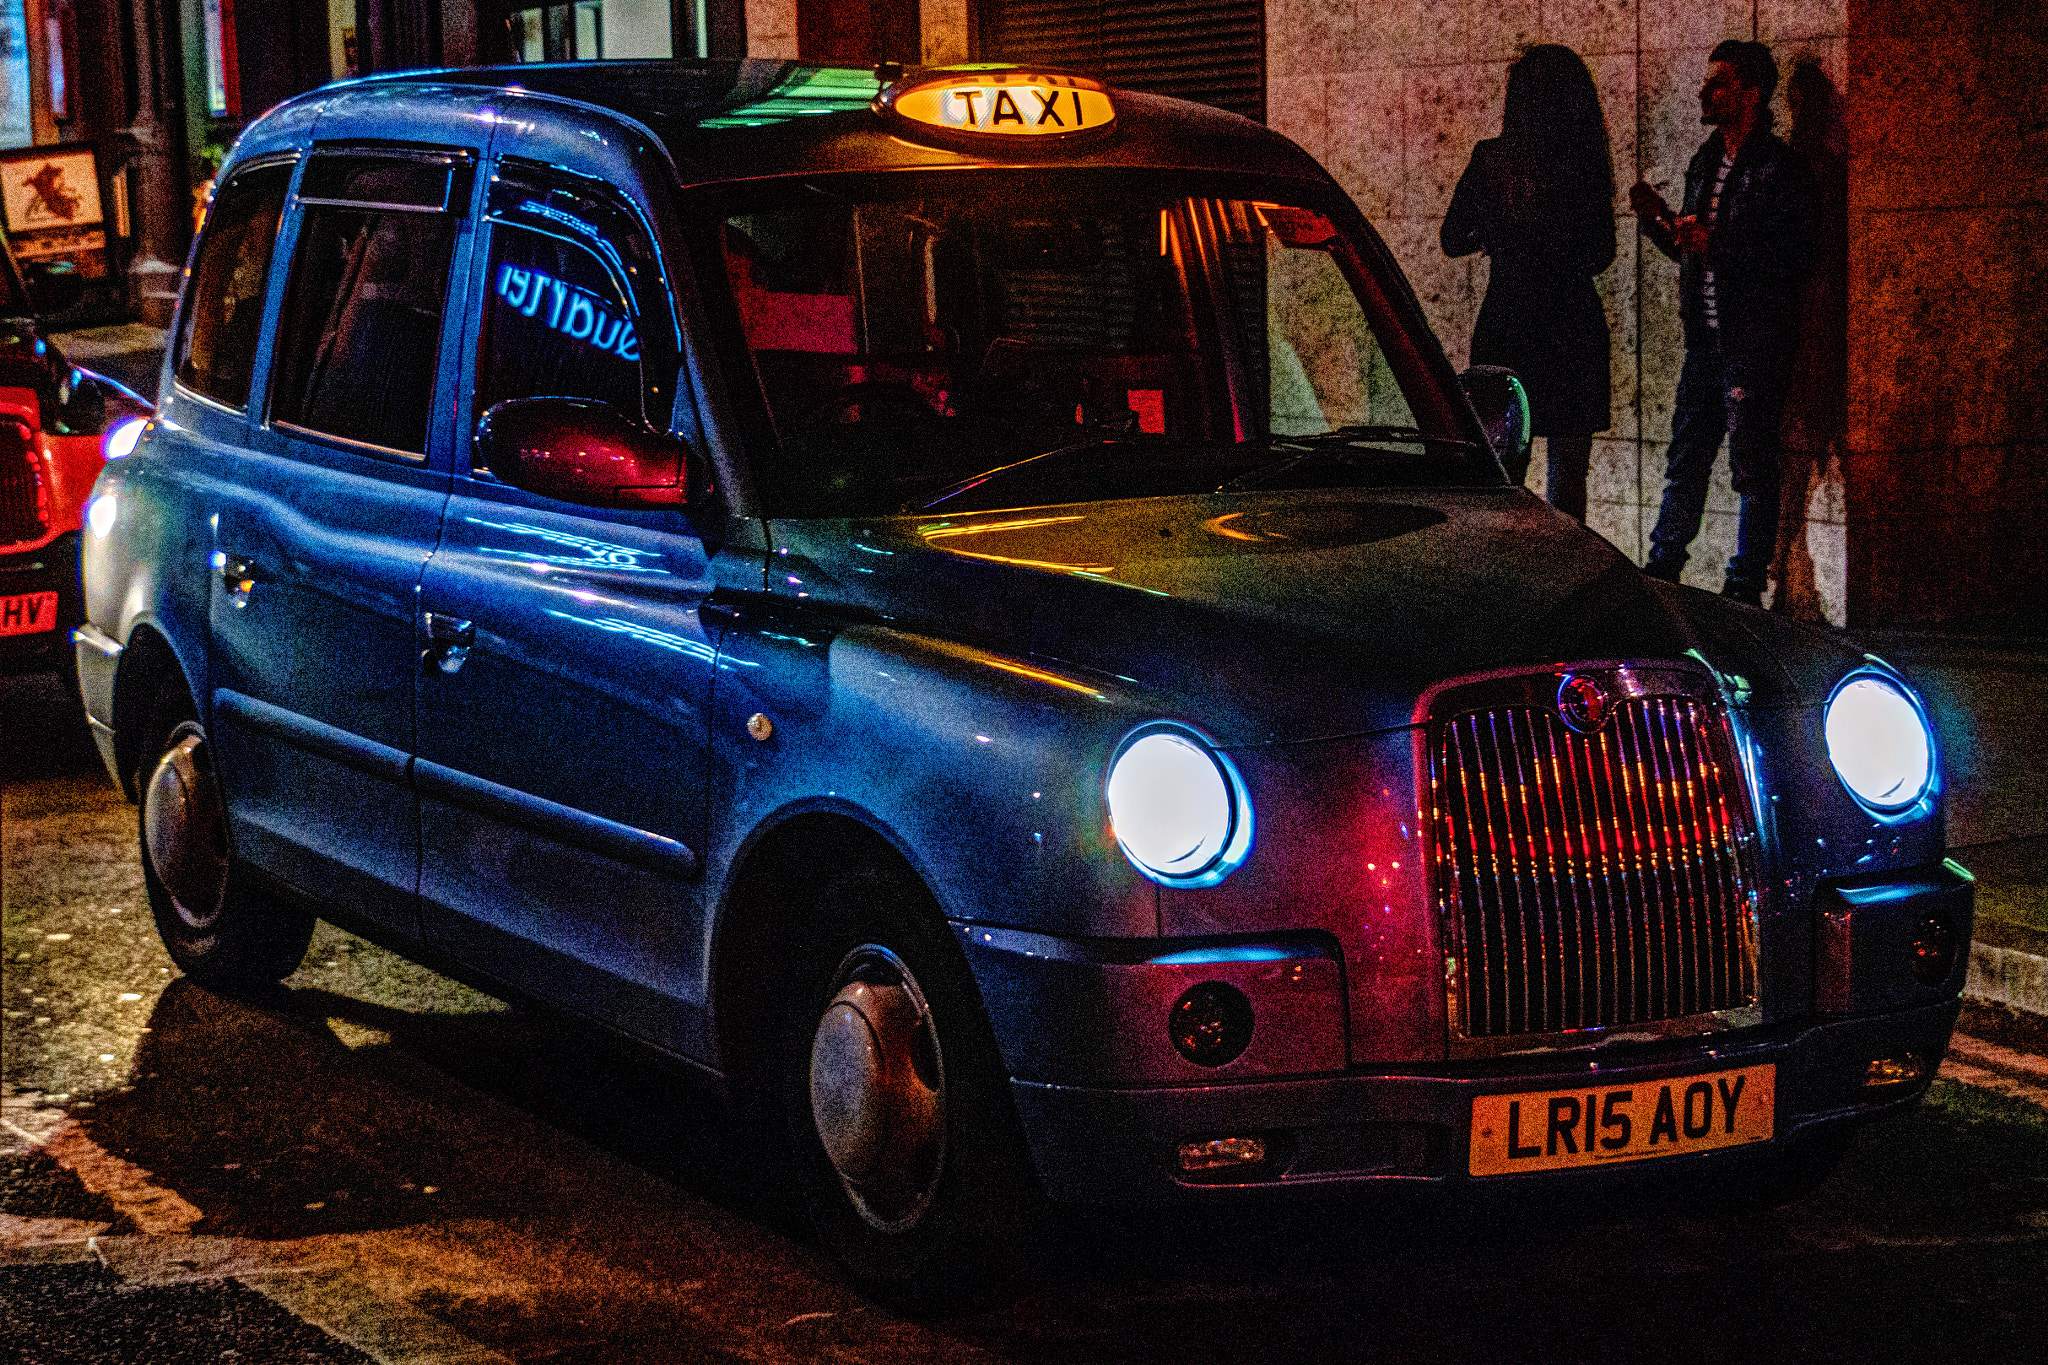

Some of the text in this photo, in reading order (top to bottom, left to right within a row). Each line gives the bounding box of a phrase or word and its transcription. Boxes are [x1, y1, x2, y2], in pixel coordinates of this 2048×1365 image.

[953, 89, 1083, 127] TAXI
[1507, 1074, 1747, 1160] LR15 AOY
